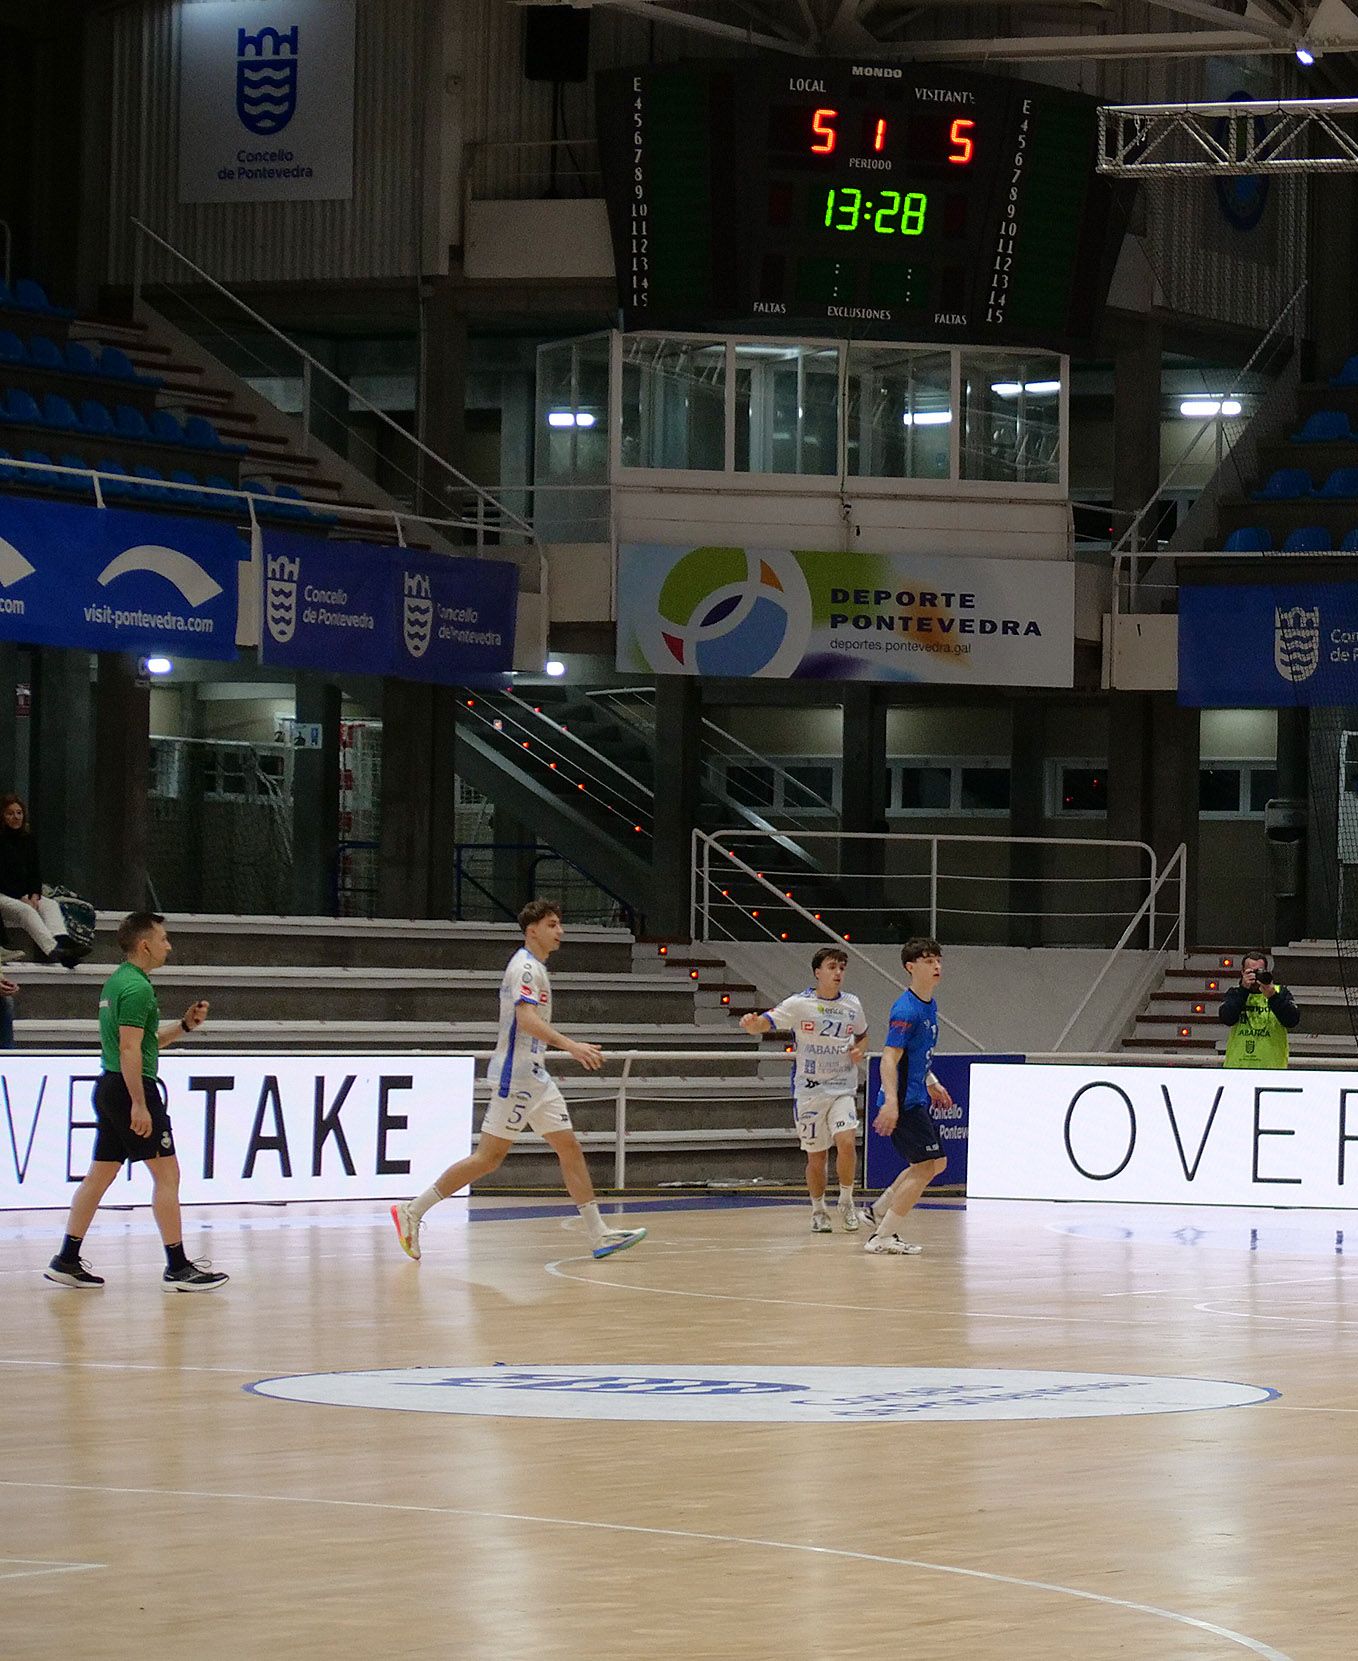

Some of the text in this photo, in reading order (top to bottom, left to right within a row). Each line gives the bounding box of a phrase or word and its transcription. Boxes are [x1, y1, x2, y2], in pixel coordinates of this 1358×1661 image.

[852, 66, 902, 79] MONDO
[633, 77, 642, 92] E
[790, 78, 826, 93] LOCAL
[634, 97, 642, 110] 4
[1022, 100, 1031, 114] E
[634, 113, 642, 128] 5
[1020, 119, 1029, 132] 4
[811, 108, 838, 152] 5
[875, 119, 886, 150] 1
[634, 131, 643, 145] 6
[948, 119, 976, 163] 5
[1017, 135, 1026, 148] 5
[237, 149, 294, 162] Concello
[634, 149, 643, 163] 7
[1015, 152, 1023, 166] 6
[849, 157, 892, 170] PERIODO
[218, 165, 313, 180] de Pontevedra
[634, 167, 643, 181] 8
[1011, 169, 1021, 183] 7
[635, 185, 643, 199] 9
[1009, 187, 1018, 201] 8
[631, 204, 648, 217] 10
[824, 188, 928, 235] 13:28
[1007, 204, 1015, 218] 9
[631, 221, 648, 235] 11
[1001, 221, 1017, 236] 10
[632, 239, 648, 253] 12
[997, 239, 1013, 254] 11
[632, 257, 648, 271] 13
[994, 256, 1012, 271] 12
[632, 275, 649, 289] 14
[992, 274, 1009, 288] 13
[632, 293, 648, 308] 15
[989, 291, 1006, 306] 14
[753, 302, 787, 314] FALTAS
[827, 306, 891, 321] EXCLUSIONES
[934, 313, 967, 325] FALTAS
[986, 308, 1003, 323] 15
[304, 585, 348, 605] Concello
[831, 588, 976, 609] DEPORTE
[84, 603, 213, 633] visit-pontevedra.com
[302, 607, 374, 630] de Pontevedra
[830, 613, 1042, 636] PONTEVEDRA
[1330, 647, 1350, 662] de
[820, 1020, 842, 1038] 21
[805, 1044, 851, 1055] ABANC
[508, 1104, 526, 1124] 5
[1, 1074, 413, 1184] VETAKE
